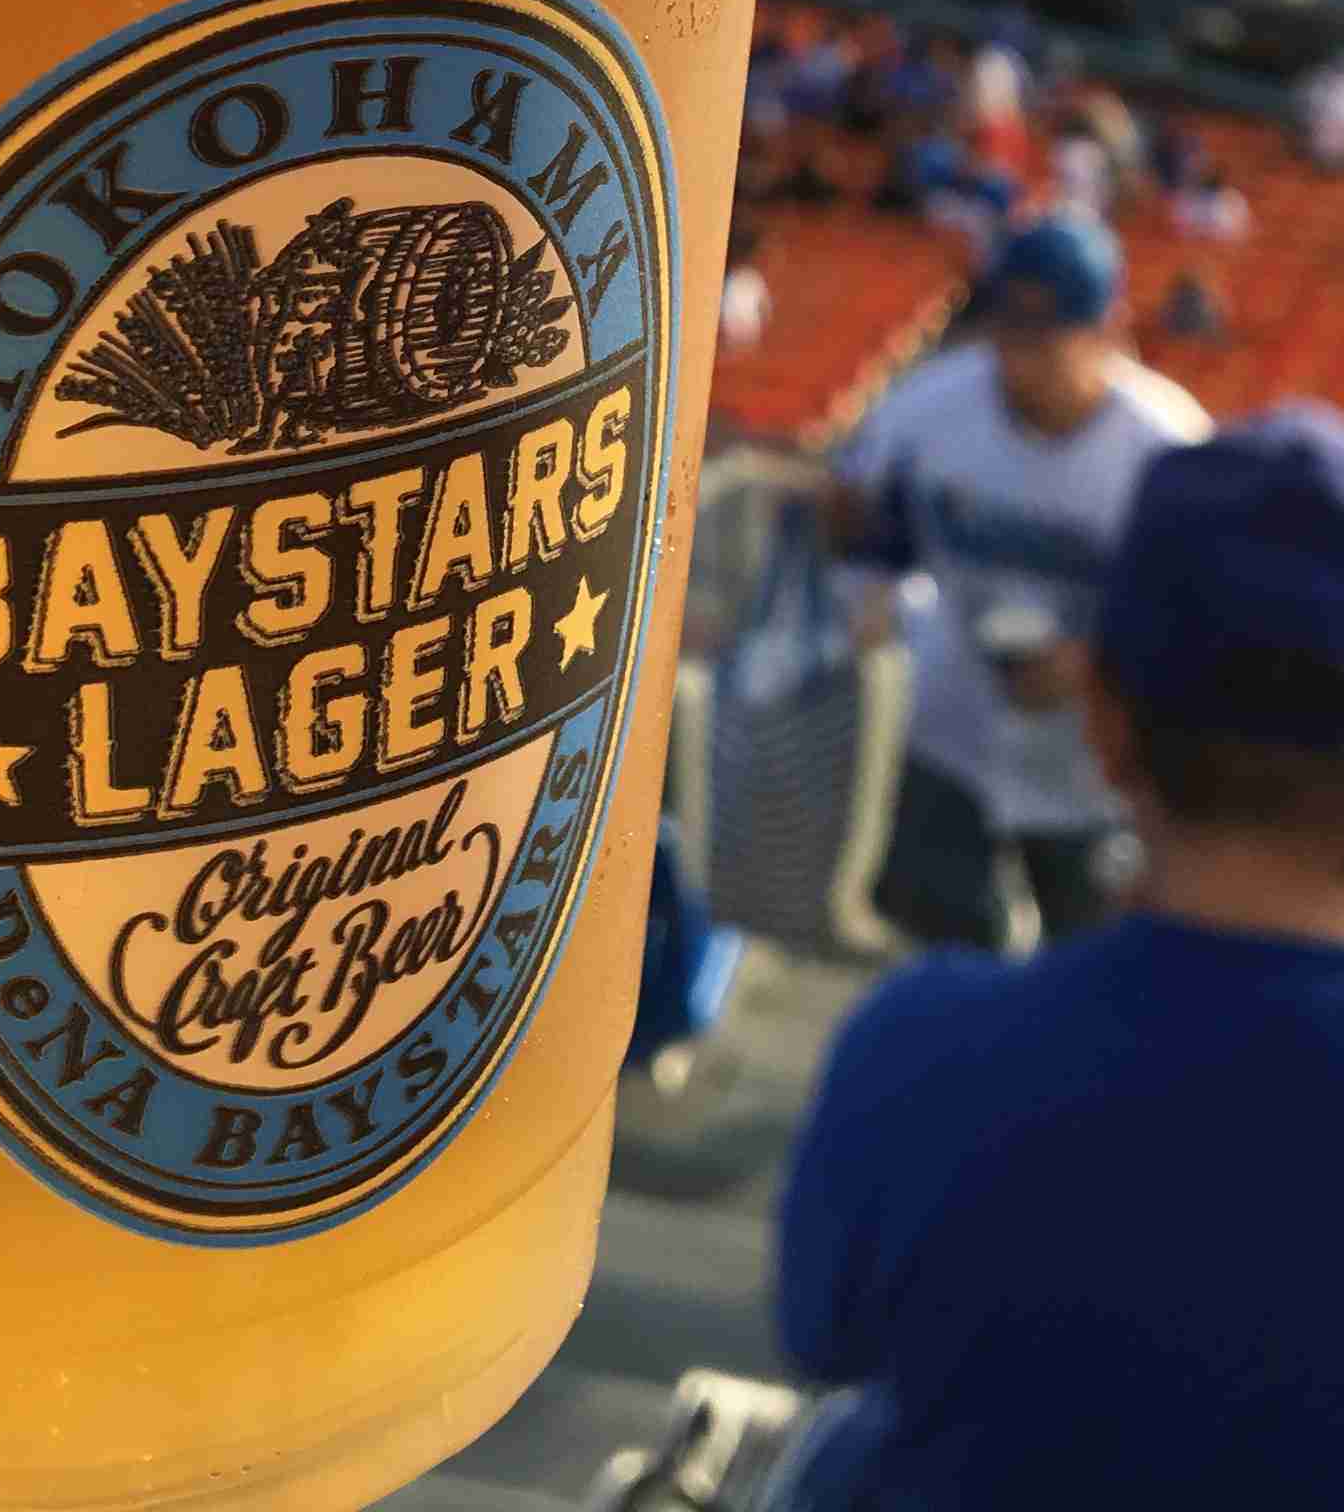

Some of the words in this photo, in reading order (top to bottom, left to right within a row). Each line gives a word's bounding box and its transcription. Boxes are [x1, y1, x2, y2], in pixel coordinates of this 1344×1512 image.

[66, 586, 534, 827] LAGER
[109, 911, 316, 1064] Craft
[268, 823, 501, 1070] Beer
[173, 779, 468, 968] Original
[192, 748, 588, 1169] BAYSTARS
